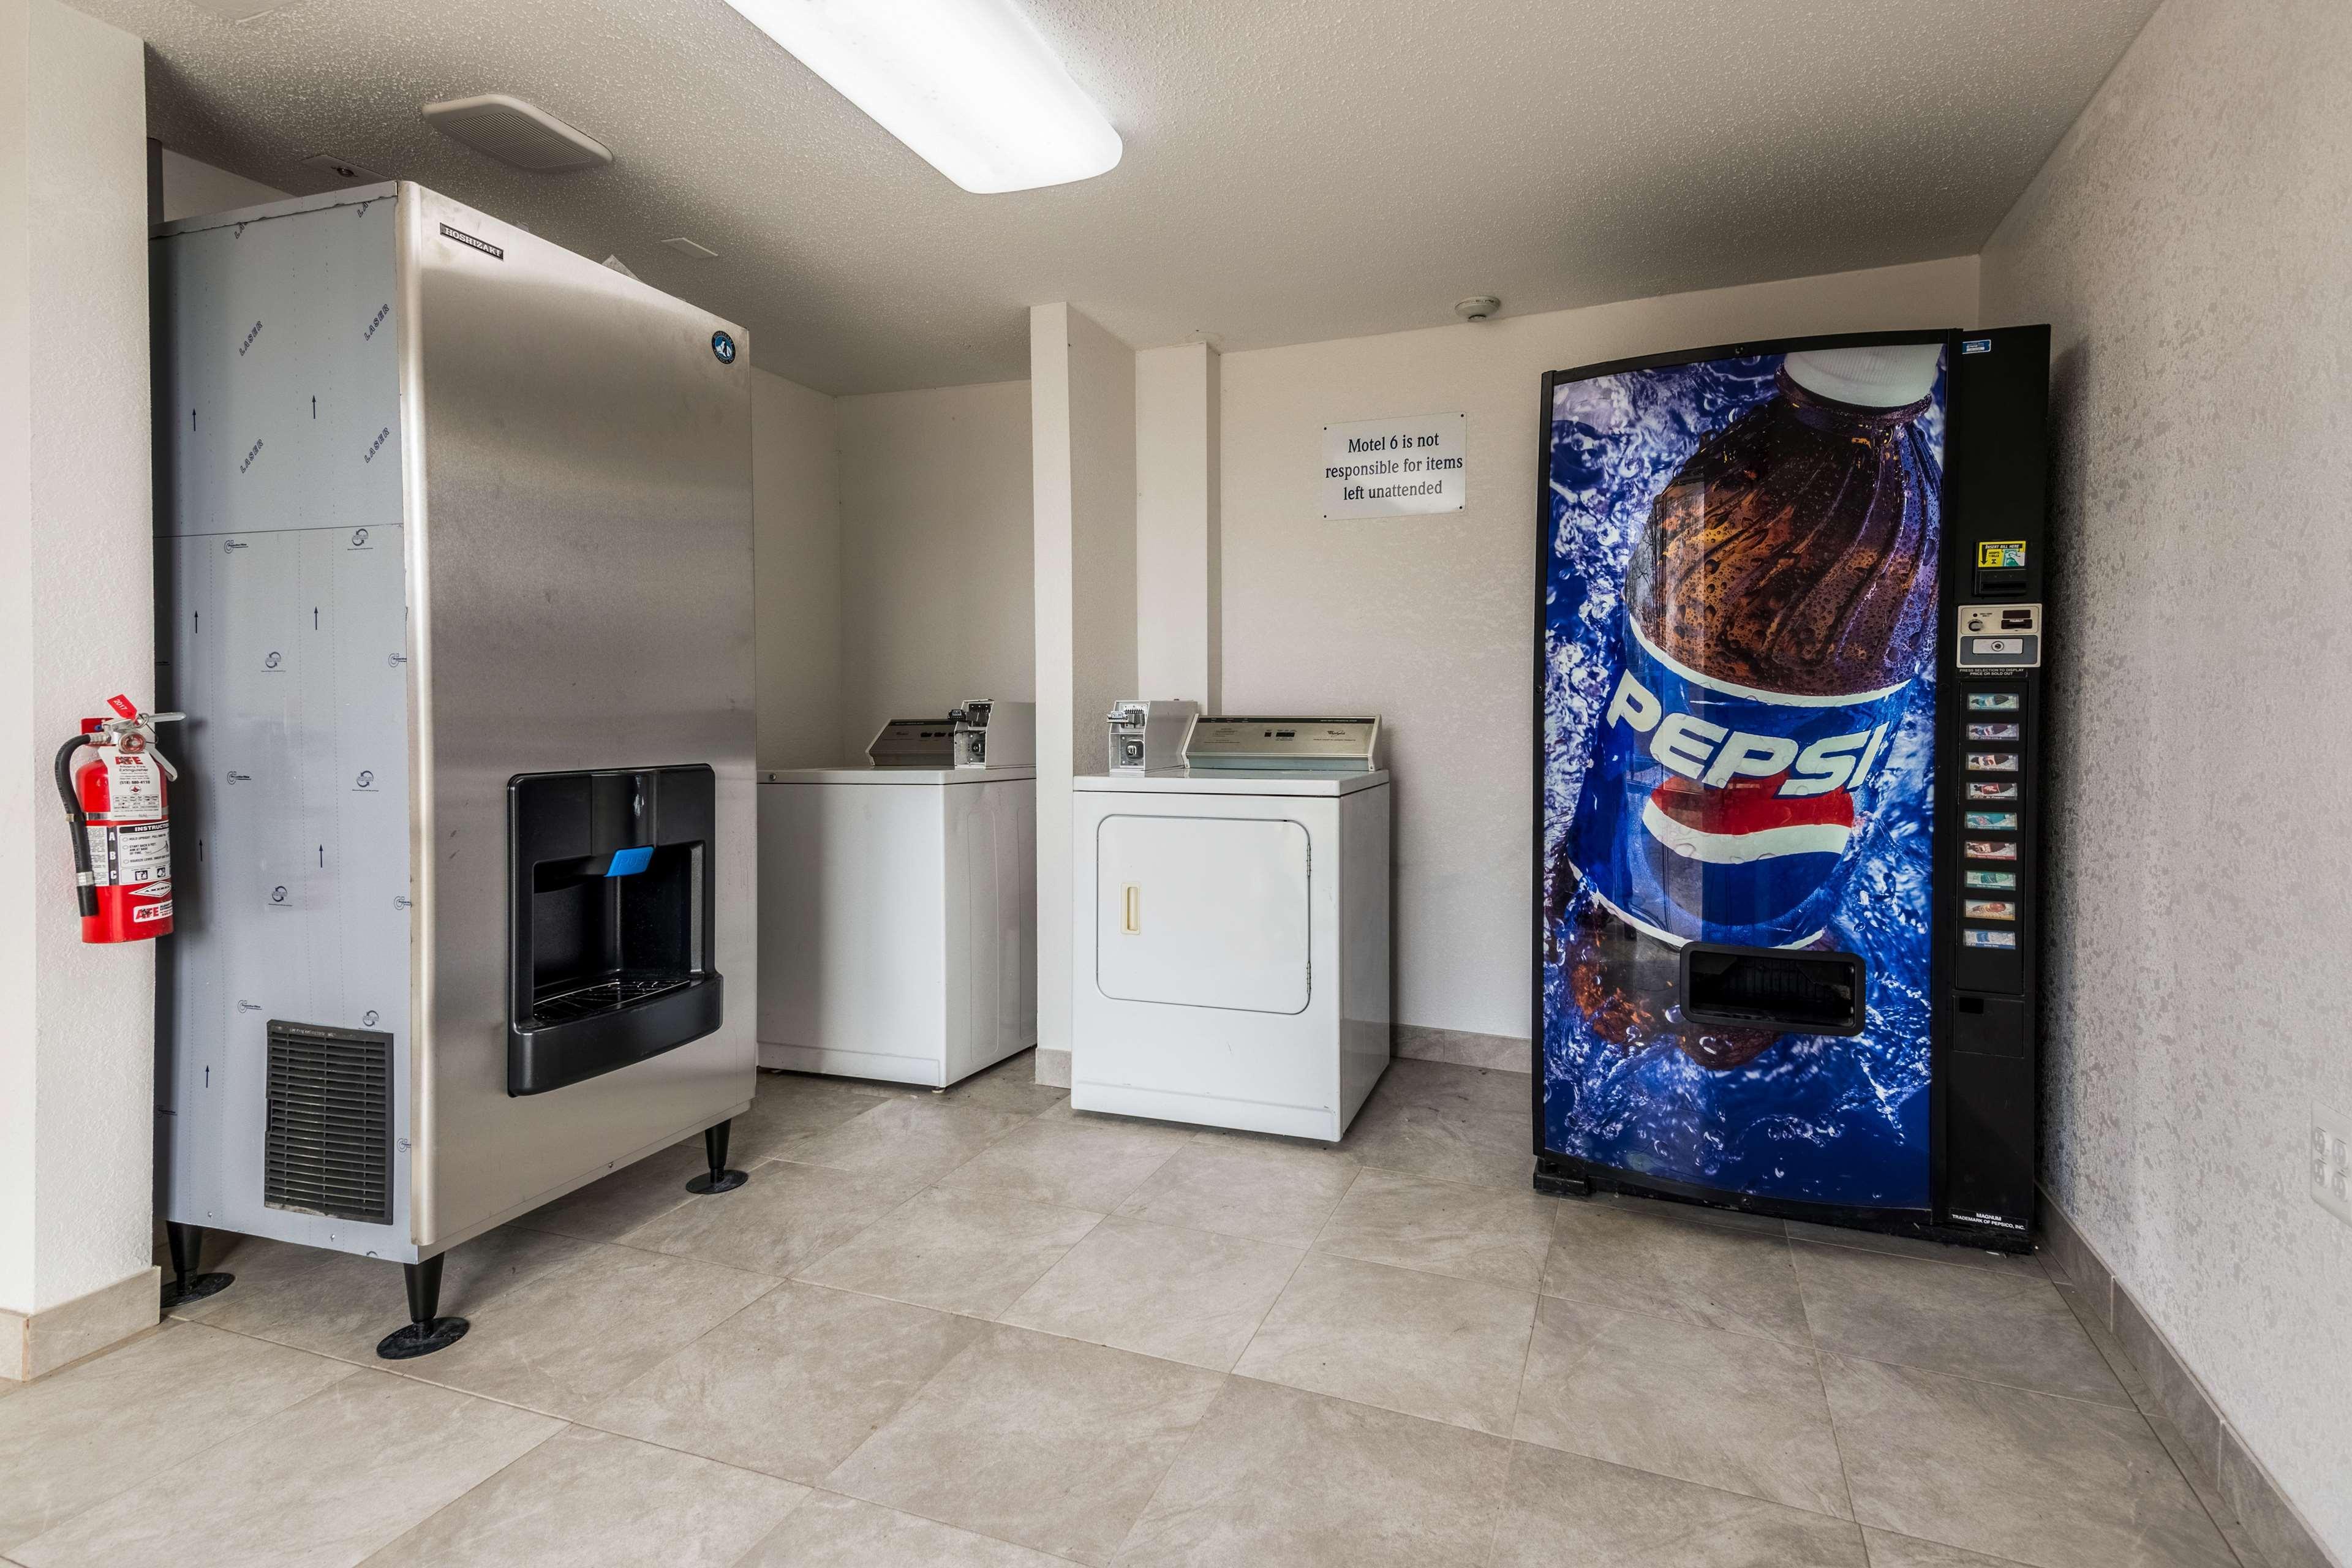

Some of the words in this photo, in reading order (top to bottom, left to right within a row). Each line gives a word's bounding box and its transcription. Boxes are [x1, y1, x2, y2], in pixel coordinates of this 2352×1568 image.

[445, 227, 502, 257] HOSHIZAKI
[363, 304, 390, 341] LASER
[239, 320, 263, 356] LASER
[363, 428, 390, 464] LASER
[1348, 437, 1385, 453] Motel
[1390, 435, 1398, 450] 6
[1402, 434, 1412, 448] is
[1417, 433, 1439, 447] not
[239, 439, 264, 474] LASER
[1325, 461, 1399, 480] responsible
[1403, 458, 1422, 472] for
[1426, 456, 1463, 470] items
[1344, 486, 1364, 500] left
[1368, 480, 1442, 499] unattended
[113, 699, 128, 710] 2017
[1606, 668, 1890, 796] PEPSI
[108, 832, 115, 841] A
[109, 851, 116, 860] B
[110, 870, 117, 880] C
[1952, 1214, 1983, 1223] TRADEMARK
[1976, 1213, 2002, 1221] MAGNUM
